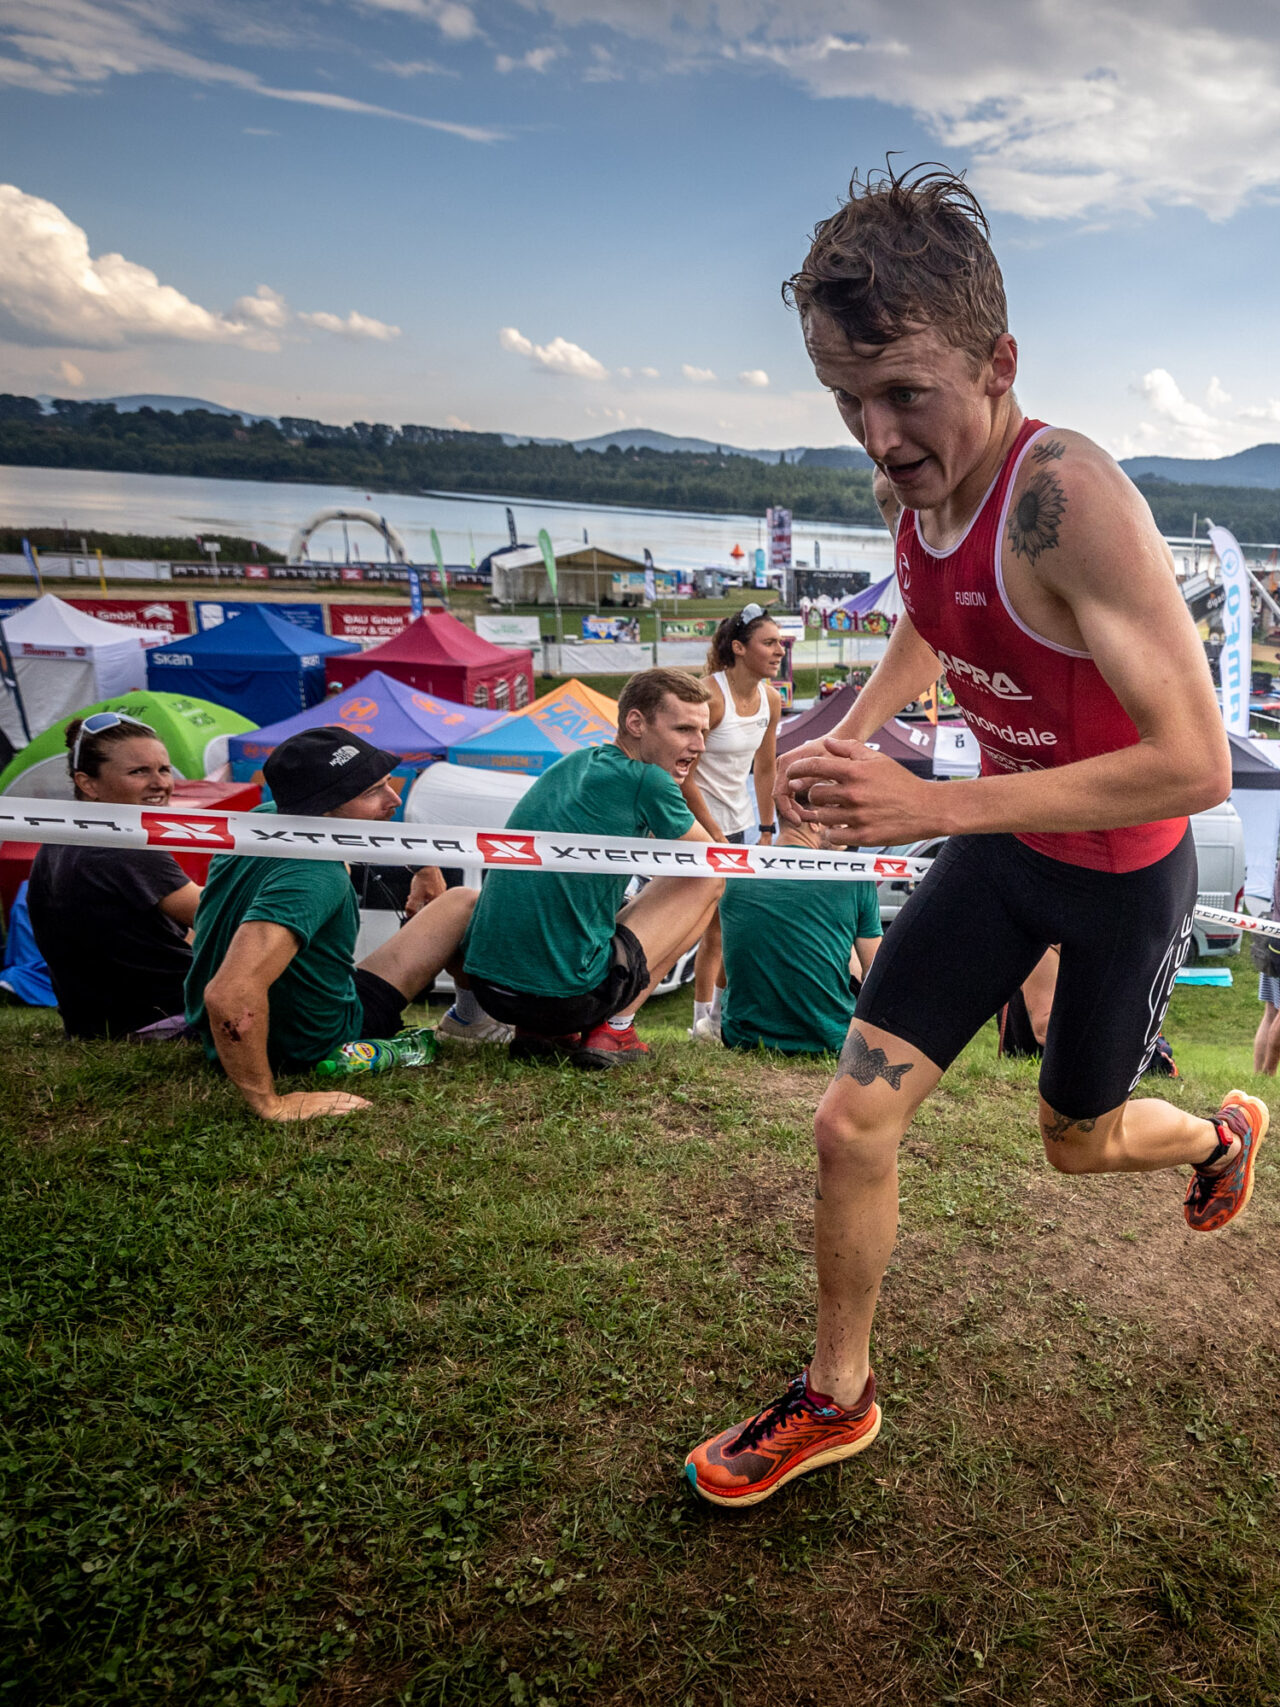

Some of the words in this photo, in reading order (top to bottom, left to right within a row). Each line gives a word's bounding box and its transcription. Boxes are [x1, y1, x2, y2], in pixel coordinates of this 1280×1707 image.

[955, 591, 987, 606] FUSION
[250, 828, 466, 854] XTERRA
[550, 845, 697, 867] XTERRA
[759, 856, 867, 873] XTERRA
